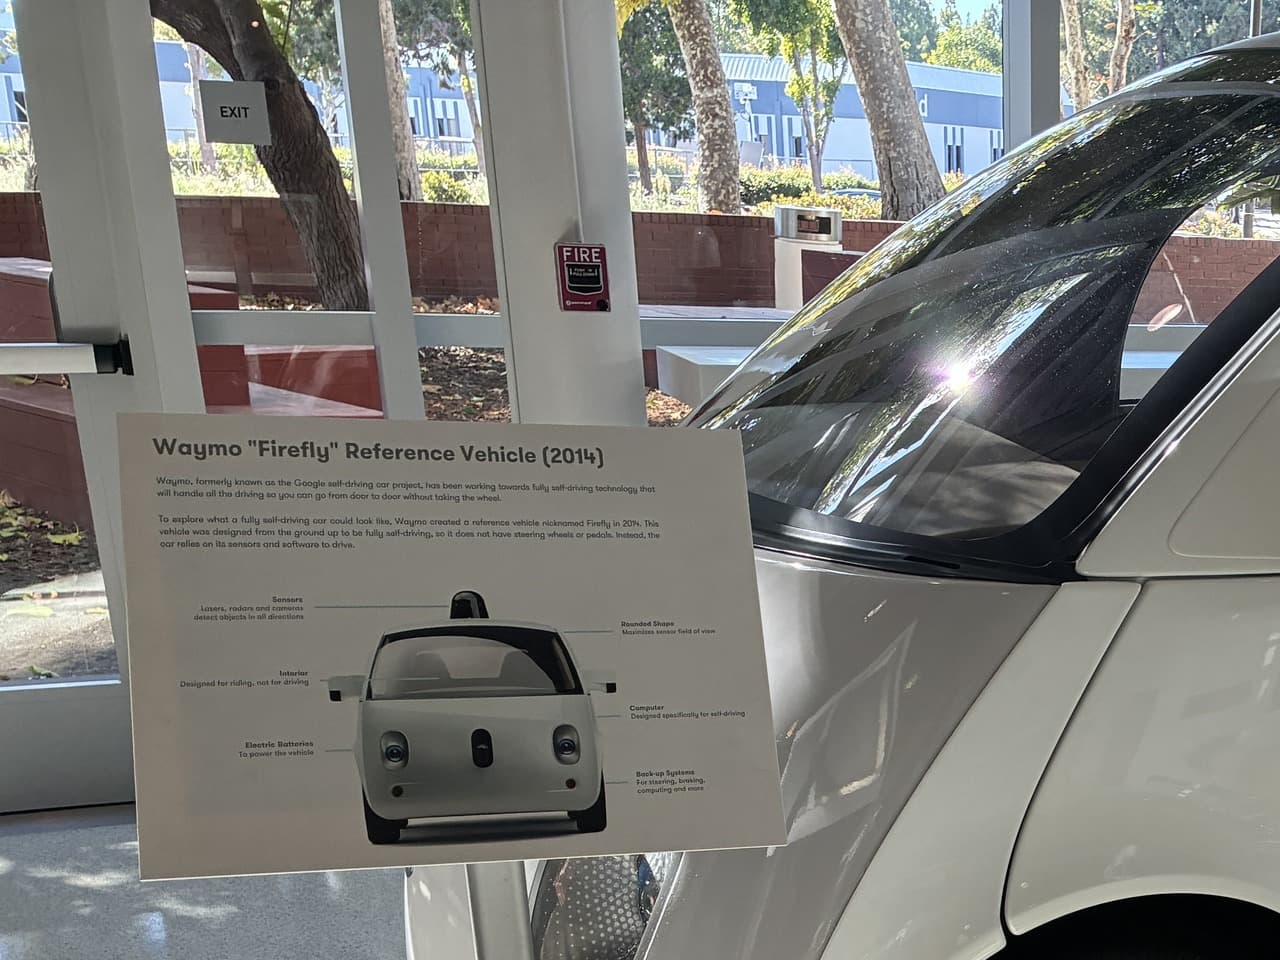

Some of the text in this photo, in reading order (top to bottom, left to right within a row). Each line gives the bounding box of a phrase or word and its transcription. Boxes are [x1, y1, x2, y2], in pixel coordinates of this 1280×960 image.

[220, 106, 249, 118] EXIT
[563, 248, 601, 262] FIRE
[152, 438, 604, 468] Waymo "Firefly" Reference Vehicle (2014)
[156, 477, 194, 488] Waymo,
[195, 477, 232, 488] formerly
[234, 478, 263, 487] known
[277, 479, 292, 487] the
[293, 479, 326, 490] Google
[327, 479, 374, 490] self-driving
[392, 480, 424, 491] project,
[425, 481, 440, 490] has
[442, 481, 463, 490] been
[464, 482, 496, 492] working
[497, 482, 530, 491] towards
[532, 483, 550, 493] fully
[551, 483, 594, 494] self-driving
[595, 484, 638, 495] technology
[639, 484, 655, 493] that
[157, 488, 171, 497] will
[173, 489, 204, 498] handle
[205, 489, 217, 498] all
[218, 489, 232, 498] the
[234, 490, 264, 500] driving
[278, 492, 295, 501] you
[314, 493, 326, 501] go
[328, 491, 348, 500] from
[349, 491, 369, 500] door
[370, 492, 380, 500] to
[381, 492, 401, 500] door
[402, 492, 433, 501] without
[434, 492, 460, 503] taking
[461, 493, 475, 502] the
[476, 493, 502, 502] wheel.
[159, 514, 169, 523] To
[171, 515, 204, 525] explore
[206, 515, 229, 524] what
[240, 515, 260, 526] fully
[262, 516, 310, 526] self-driving
[329, 516, 353, 525] could
[355, 516, 374, 525] look
[375, 517, 393, 527] like,
[394, 517, 427, 528] Waymo
[429, 517, 461, 526] created
[472, 518, 510, 526] reference
[511, 518, 540, 527] vehicle
[541, 518, 584, 527] nicknamed
[586, 519, 611, 529] Firefly
[612, 519, 620, 528] in
[622, 519, 642, 528] 2014.
[644, 519, 659, 528] This
[159, 527, 190, 536] vehicle
[212, 527, 252, 538] designed
[254, 528, 275, 536] from
[277, 528, 292, 537] the
[293, 528, 325, 539] ground
[327, 530, 339, 539] up
[340, 528, 350, 537] to
[351, 528, 363, 537] be
[365, 529, 384, 539] fully
[385, 529, 434, 540] self-driving,
[447, 529, 453, 538] it
[455, 529, 475, 538] does
[476, 530, 490, 538] not
[491, 530, 512, 538] have
[513, 530, 546, 540] steering
[547, 530, 574, 539] wheels
[585, 530, 614, 541] pedals.
[615, 531, 647, 541] Instead,
[647, 531, 660, 540] the
[176, 539, 200, 548] relies
[215, 539, 226, 548] its
[262, 540, 280, 548] and
[281, 540, 320, 548] software
[321, 540, 330, 548] to
[652, 620, 674, 629] Shape
[629, 705, 664, 713] Computer
[636, 769, 695, 779] Back-up Systems
